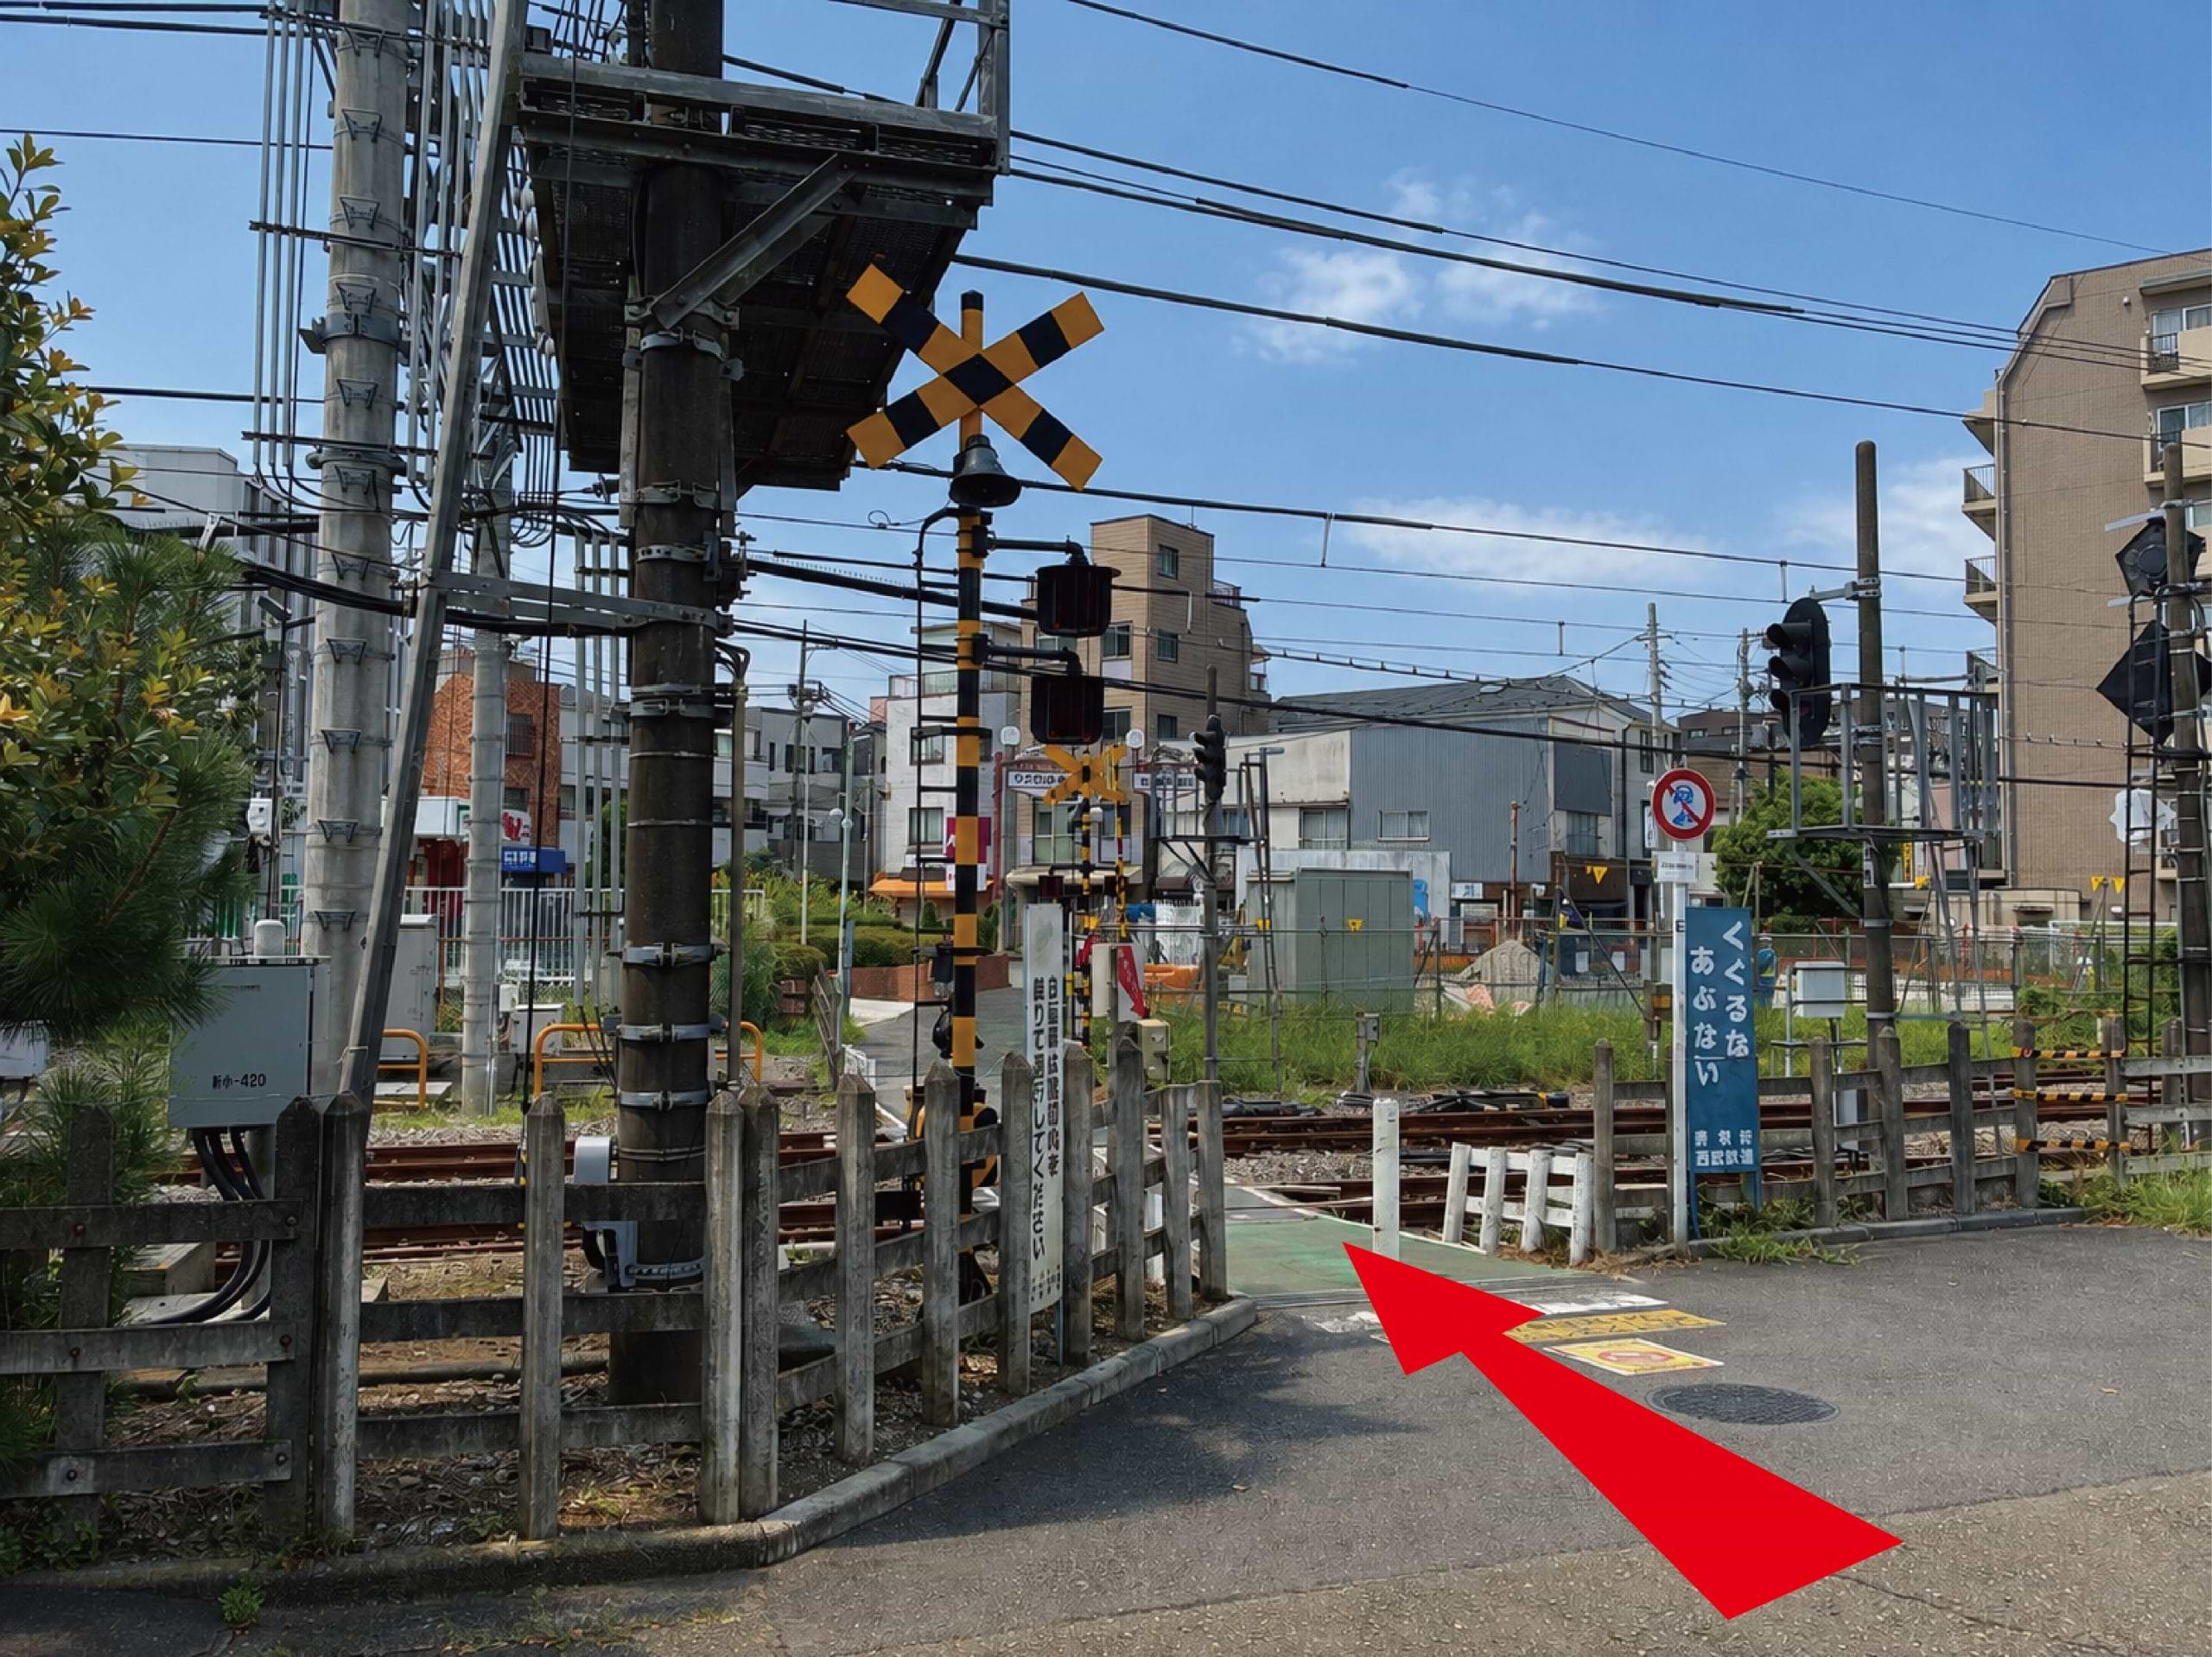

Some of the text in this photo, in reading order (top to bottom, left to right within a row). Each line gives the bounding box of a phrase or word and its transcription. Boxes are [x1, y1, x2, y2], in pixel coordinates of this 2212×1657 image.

[1690, 946, 1719, 1086] あぶない
[1723, 921, 1749, 1057] くぐるな
